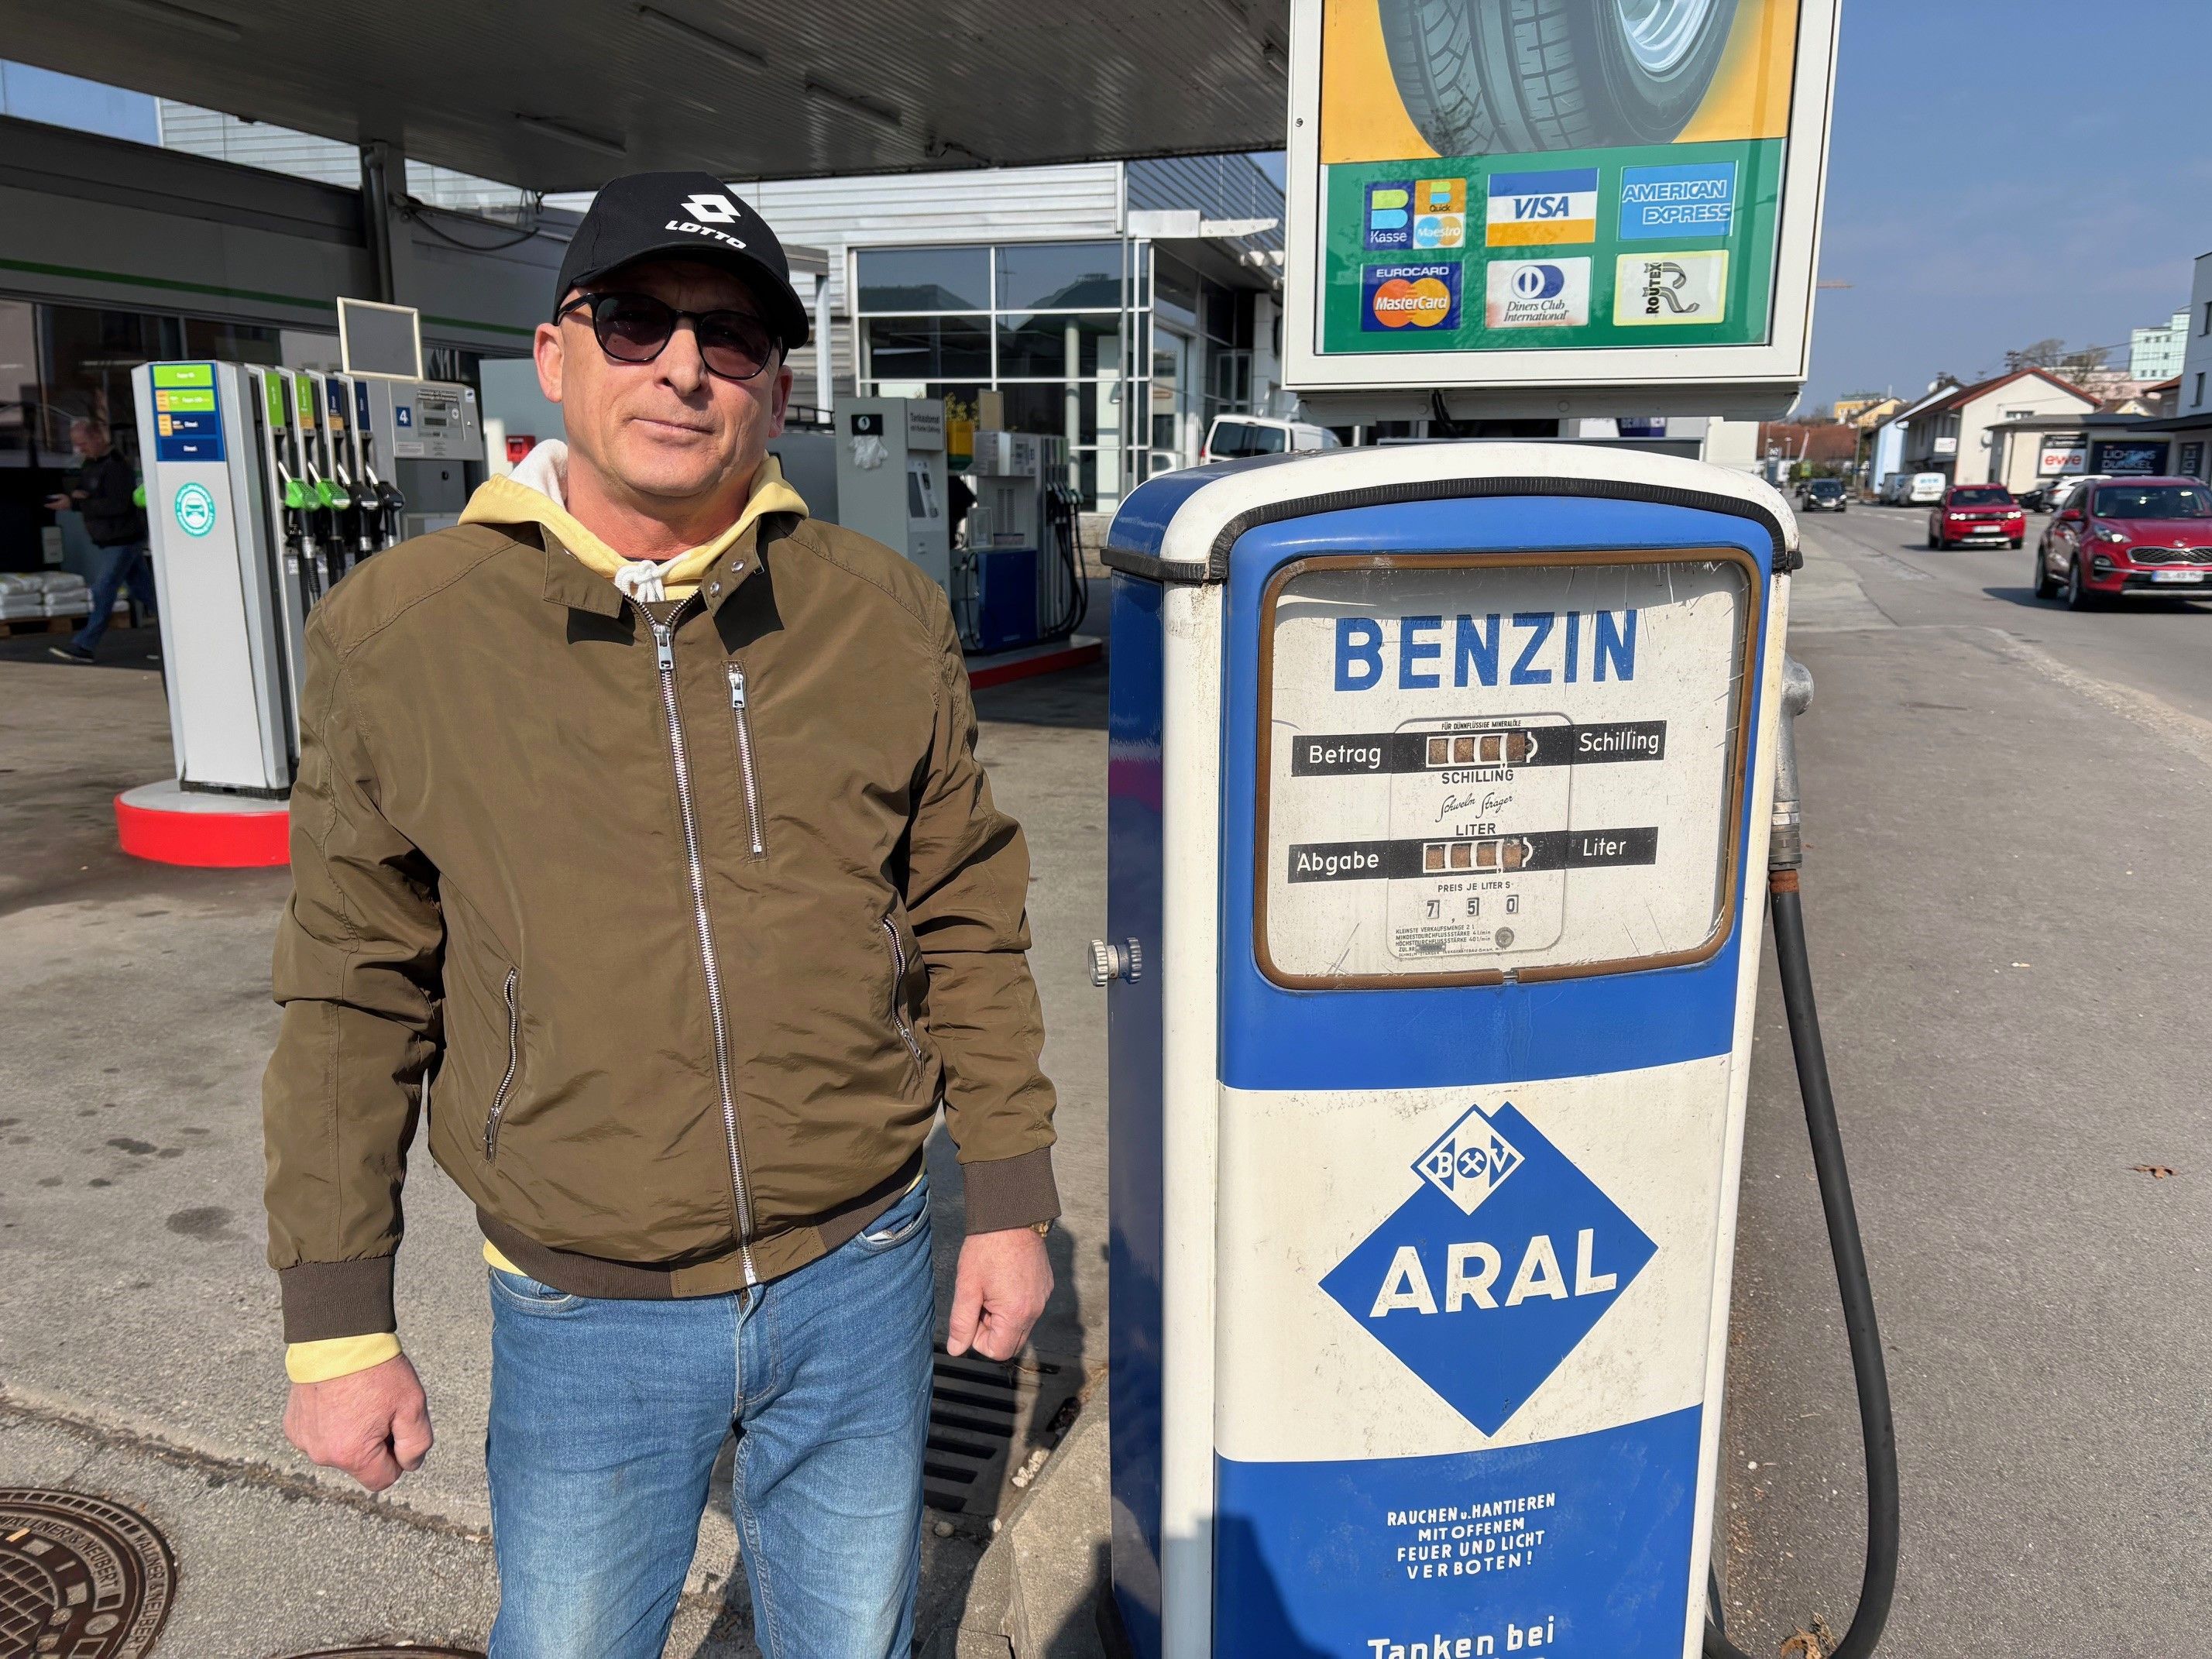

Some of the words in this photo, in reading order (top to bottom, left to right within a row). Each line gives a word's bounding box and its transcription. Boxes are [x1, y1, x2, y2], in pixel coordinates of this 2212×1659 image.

[1622, 180, 1727, 203] AMERICAN
[1429, 204, 1451, 213] Quick
[1513, 195, 1569, 220] VISA
[1643, 203, 1731, 225] EXPRESS
[665, 220, 747, 249] LOTTO
[1370, 231, 1408, 243] Kasse
[1418, 226, 1461, 237] Maestro
[1376, 266, 1449, 278] EUROCARD
[1646, 262, 1663, 314] ROUTEX
[1376, 296, 1448, 311] MasterCard
[1507, 301, 1539, 312] Diners
[1540, 300, 1565, 311] Club
[1503, 310, 1568, 322] International
[399, 410, 409, 424] 4
[1334, 609, 1637, 692] BENZIN
[1441, 722, 1452, 730] FÜR
[1454, 720, 1489, 730] DÜNNFLÜSSIGE
[1309, 744, 1382, 769] Betrag
[1578, 730, 1660, 757] Schilling
[1441, 769, 1514, 785] SCHILLING
[1456, 823, 1496, 836] LITER
[1297, 852, 1379, 876] Abgabe
[1582, 837, 1626, 857] Liter
[1437, 883, 1463, 892] PREIS
[1482, 881, 1503, 890] LITER
[1369, 1228, 1617, 1317] ARAL
[1387, 1507, 1458, 1526] RAUCHEN
[1418, 1527, 1448, 1542] MIT
[1451, 1517, 1525, 1540] OFFENEM
[1397, 1544, 1452, 1561] FEUER
[1460, 1538, 1496, 1557] UND
[1501, 1530, 1545, 1550] LICHT
[1368, 1634, 1494, 1659] Tanken
[1507, 1616, 1554, 1651] bei
